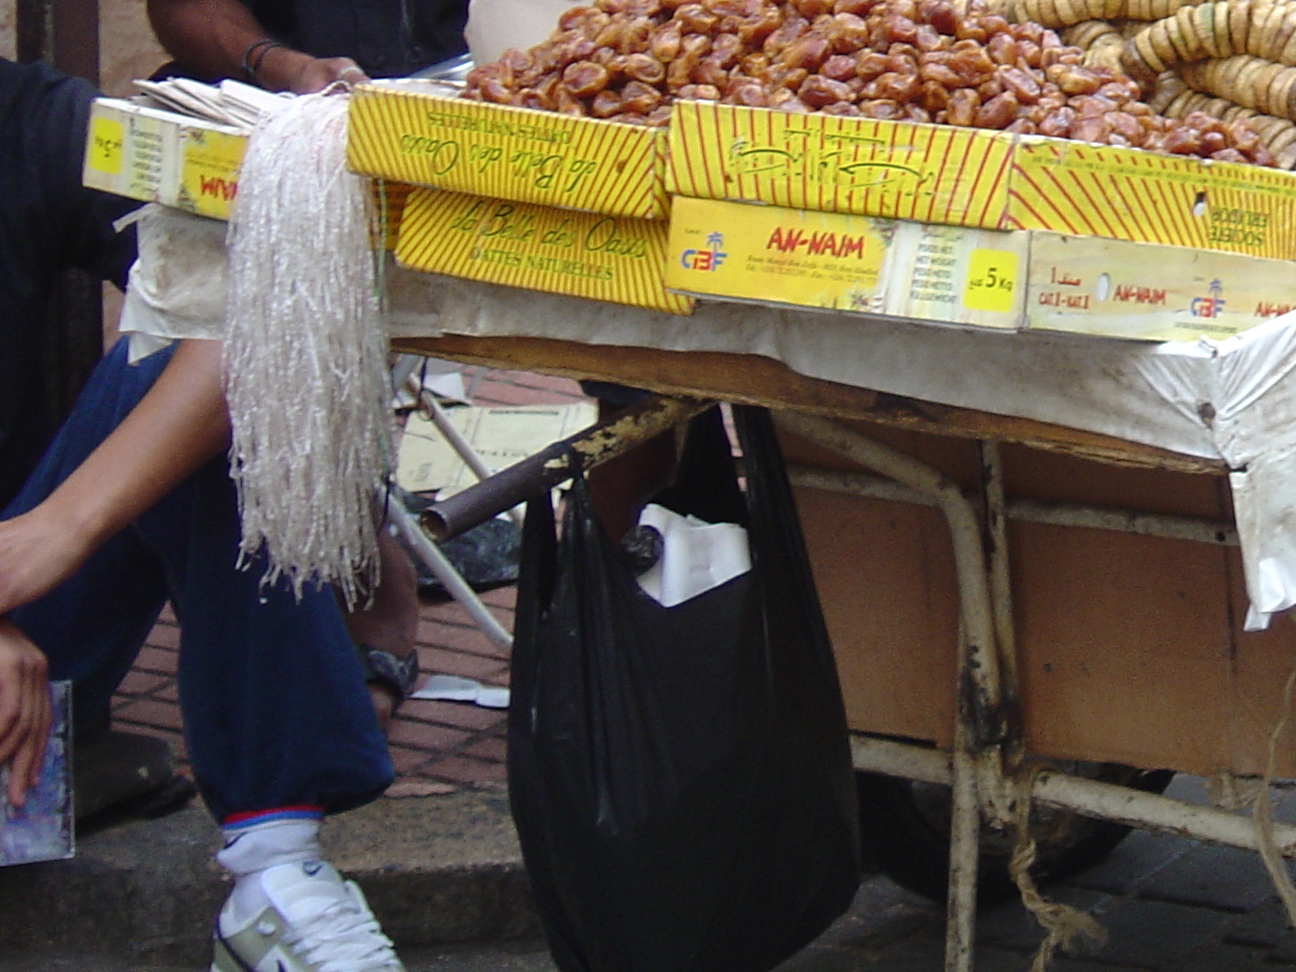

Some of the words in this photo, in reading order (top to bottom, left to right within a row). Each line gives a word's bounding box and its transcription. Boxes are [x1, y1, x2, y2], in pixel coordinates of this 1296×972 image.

[400, 133, 460, 176] Oasis
[470, 142, 503, 174] des
[511, 152, 562, 189] Belle
[482, 204, 535, 242] Belle
[541, 218, 574, 247] des
[585, 217, 647, 258] Oasis
[766, 227, 864, 259] AN-NAIM
[470, 247, 522, 267] DATTES
[528, 255, 613, 280] NATURELLES
[986, 267, 998, 288] 5
